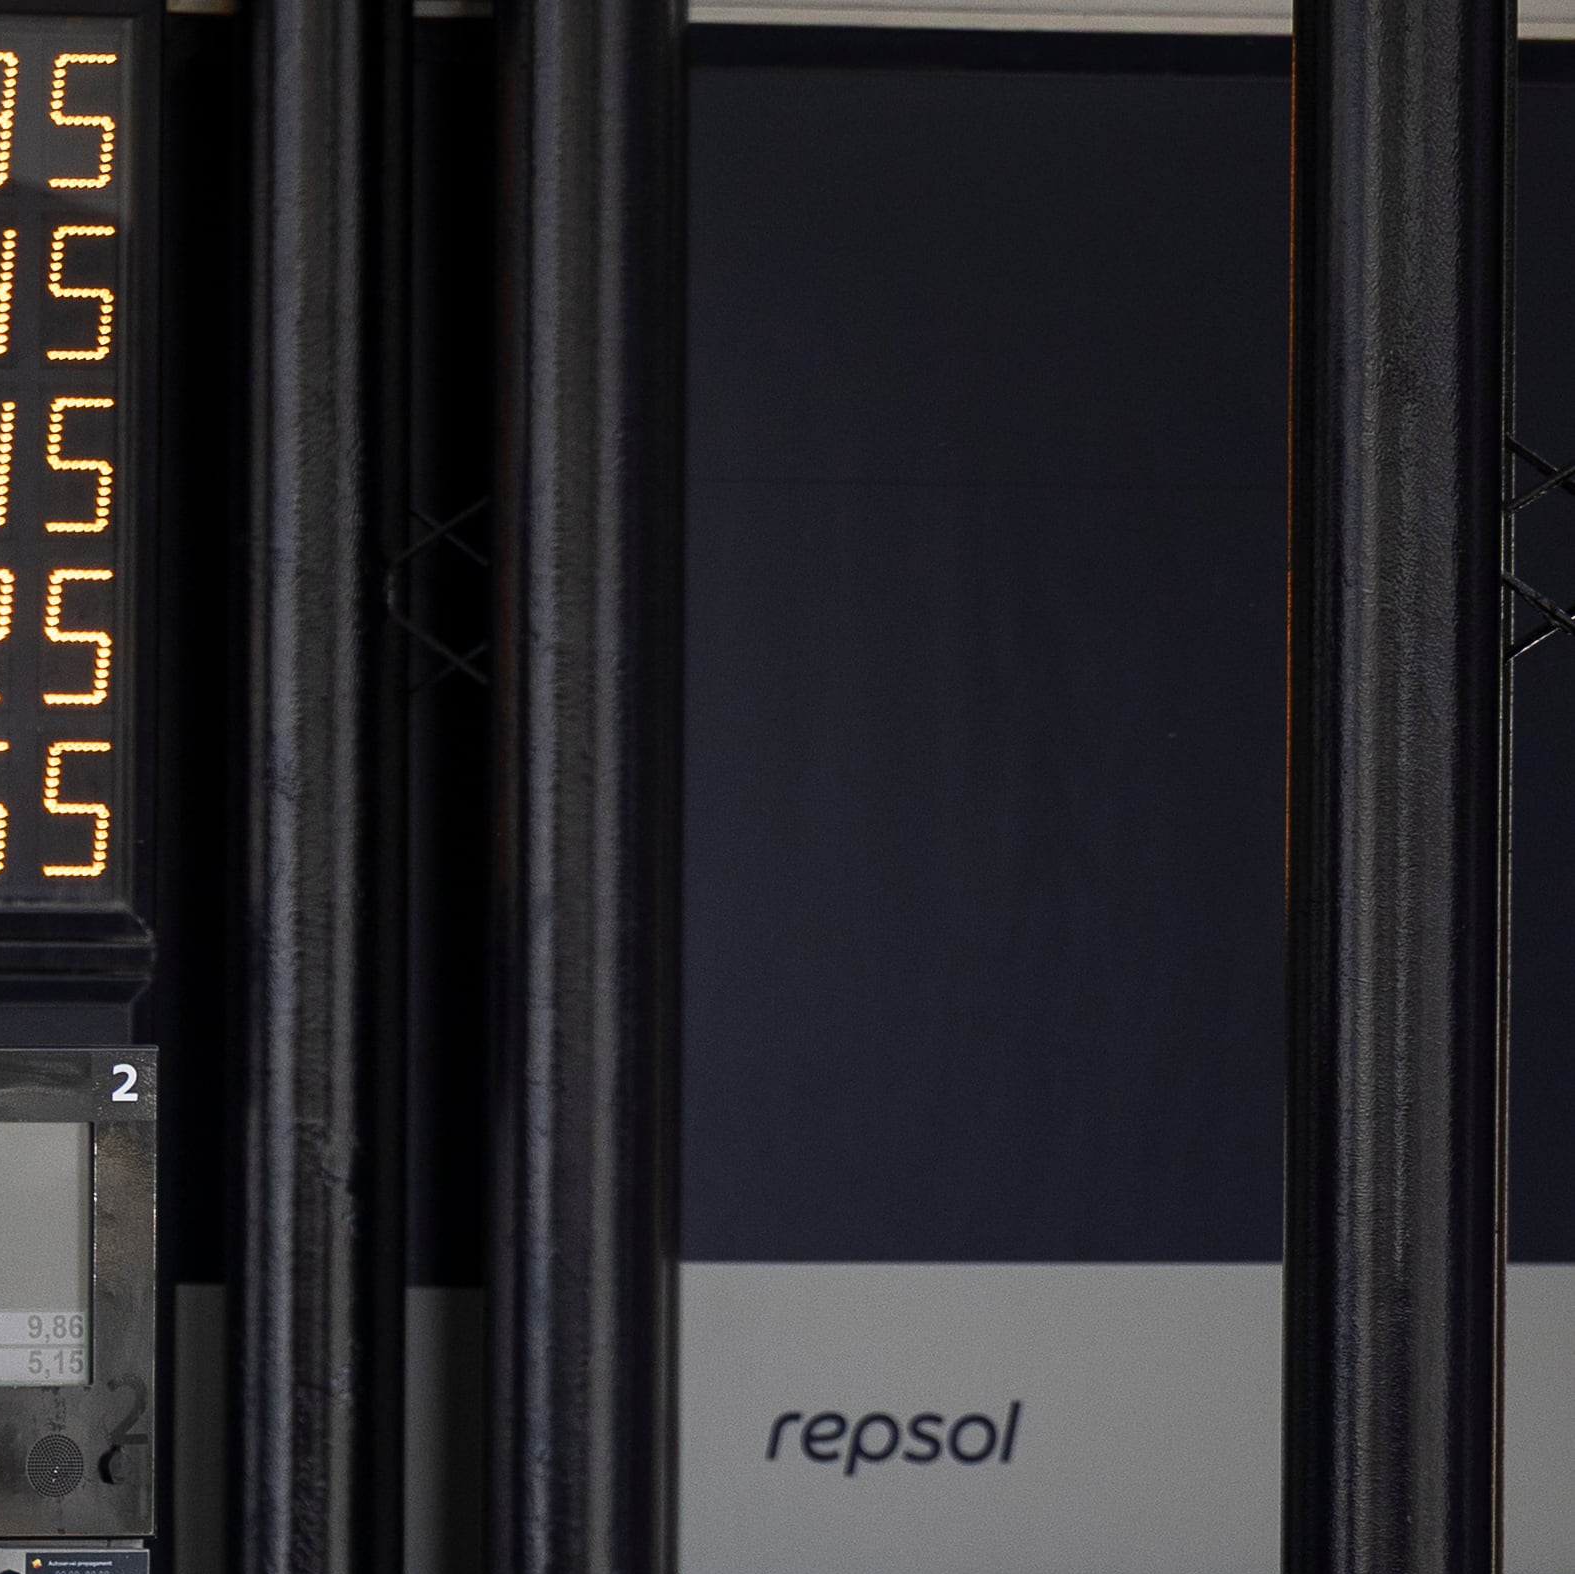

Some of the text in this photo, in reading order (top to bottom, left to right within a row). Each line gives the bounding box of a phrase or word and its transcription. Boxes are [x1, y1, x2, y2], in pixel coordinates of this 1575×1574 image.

[112, 1064, 139, 1102] 2
[27, 1315, 83, 1344] 9,86
[28, 1351, 84, 1379] 5,15
[765, 1401, 1020, 1476] repsol
